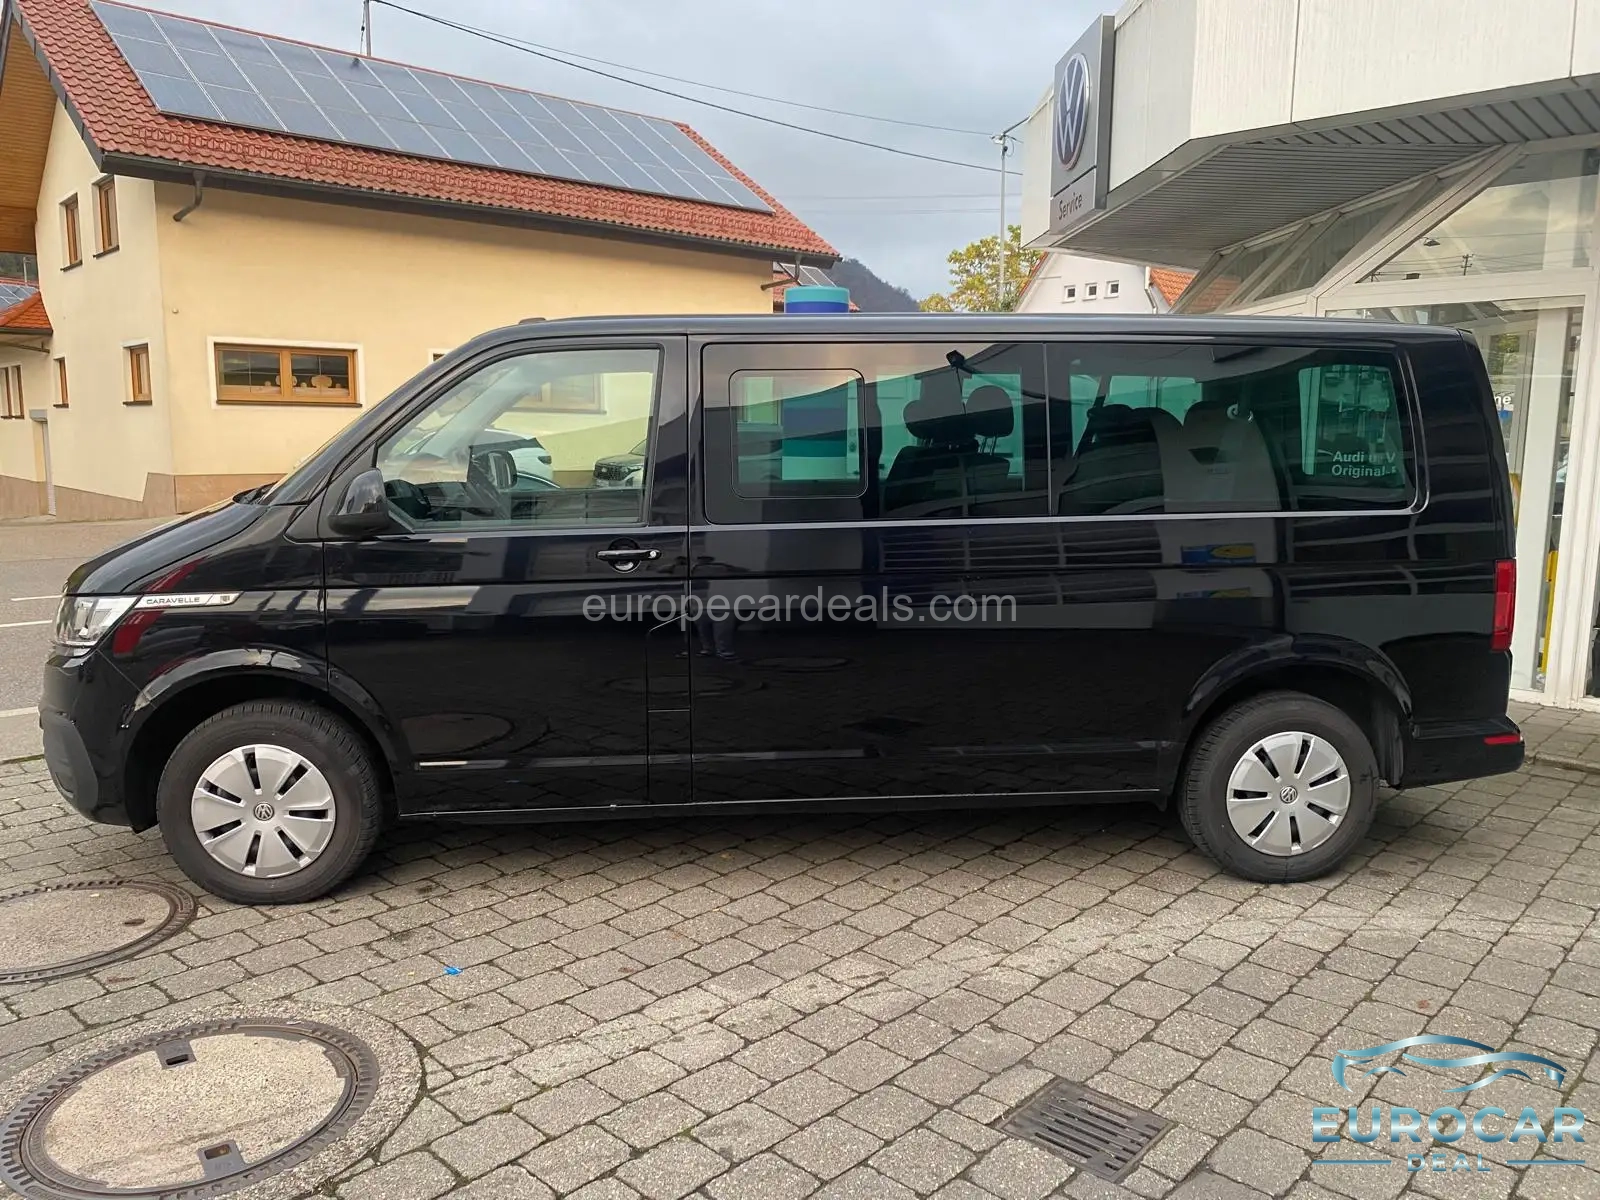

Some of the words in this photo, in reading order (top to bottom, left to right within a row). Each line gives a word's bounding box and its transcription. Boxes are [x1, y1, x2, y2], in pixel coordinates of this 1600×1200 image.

[1058, 191, 1083, 220] Service
[1332, 450, 1365, 462] Audi
[146, 596, 200, 605] CARAVELLE
